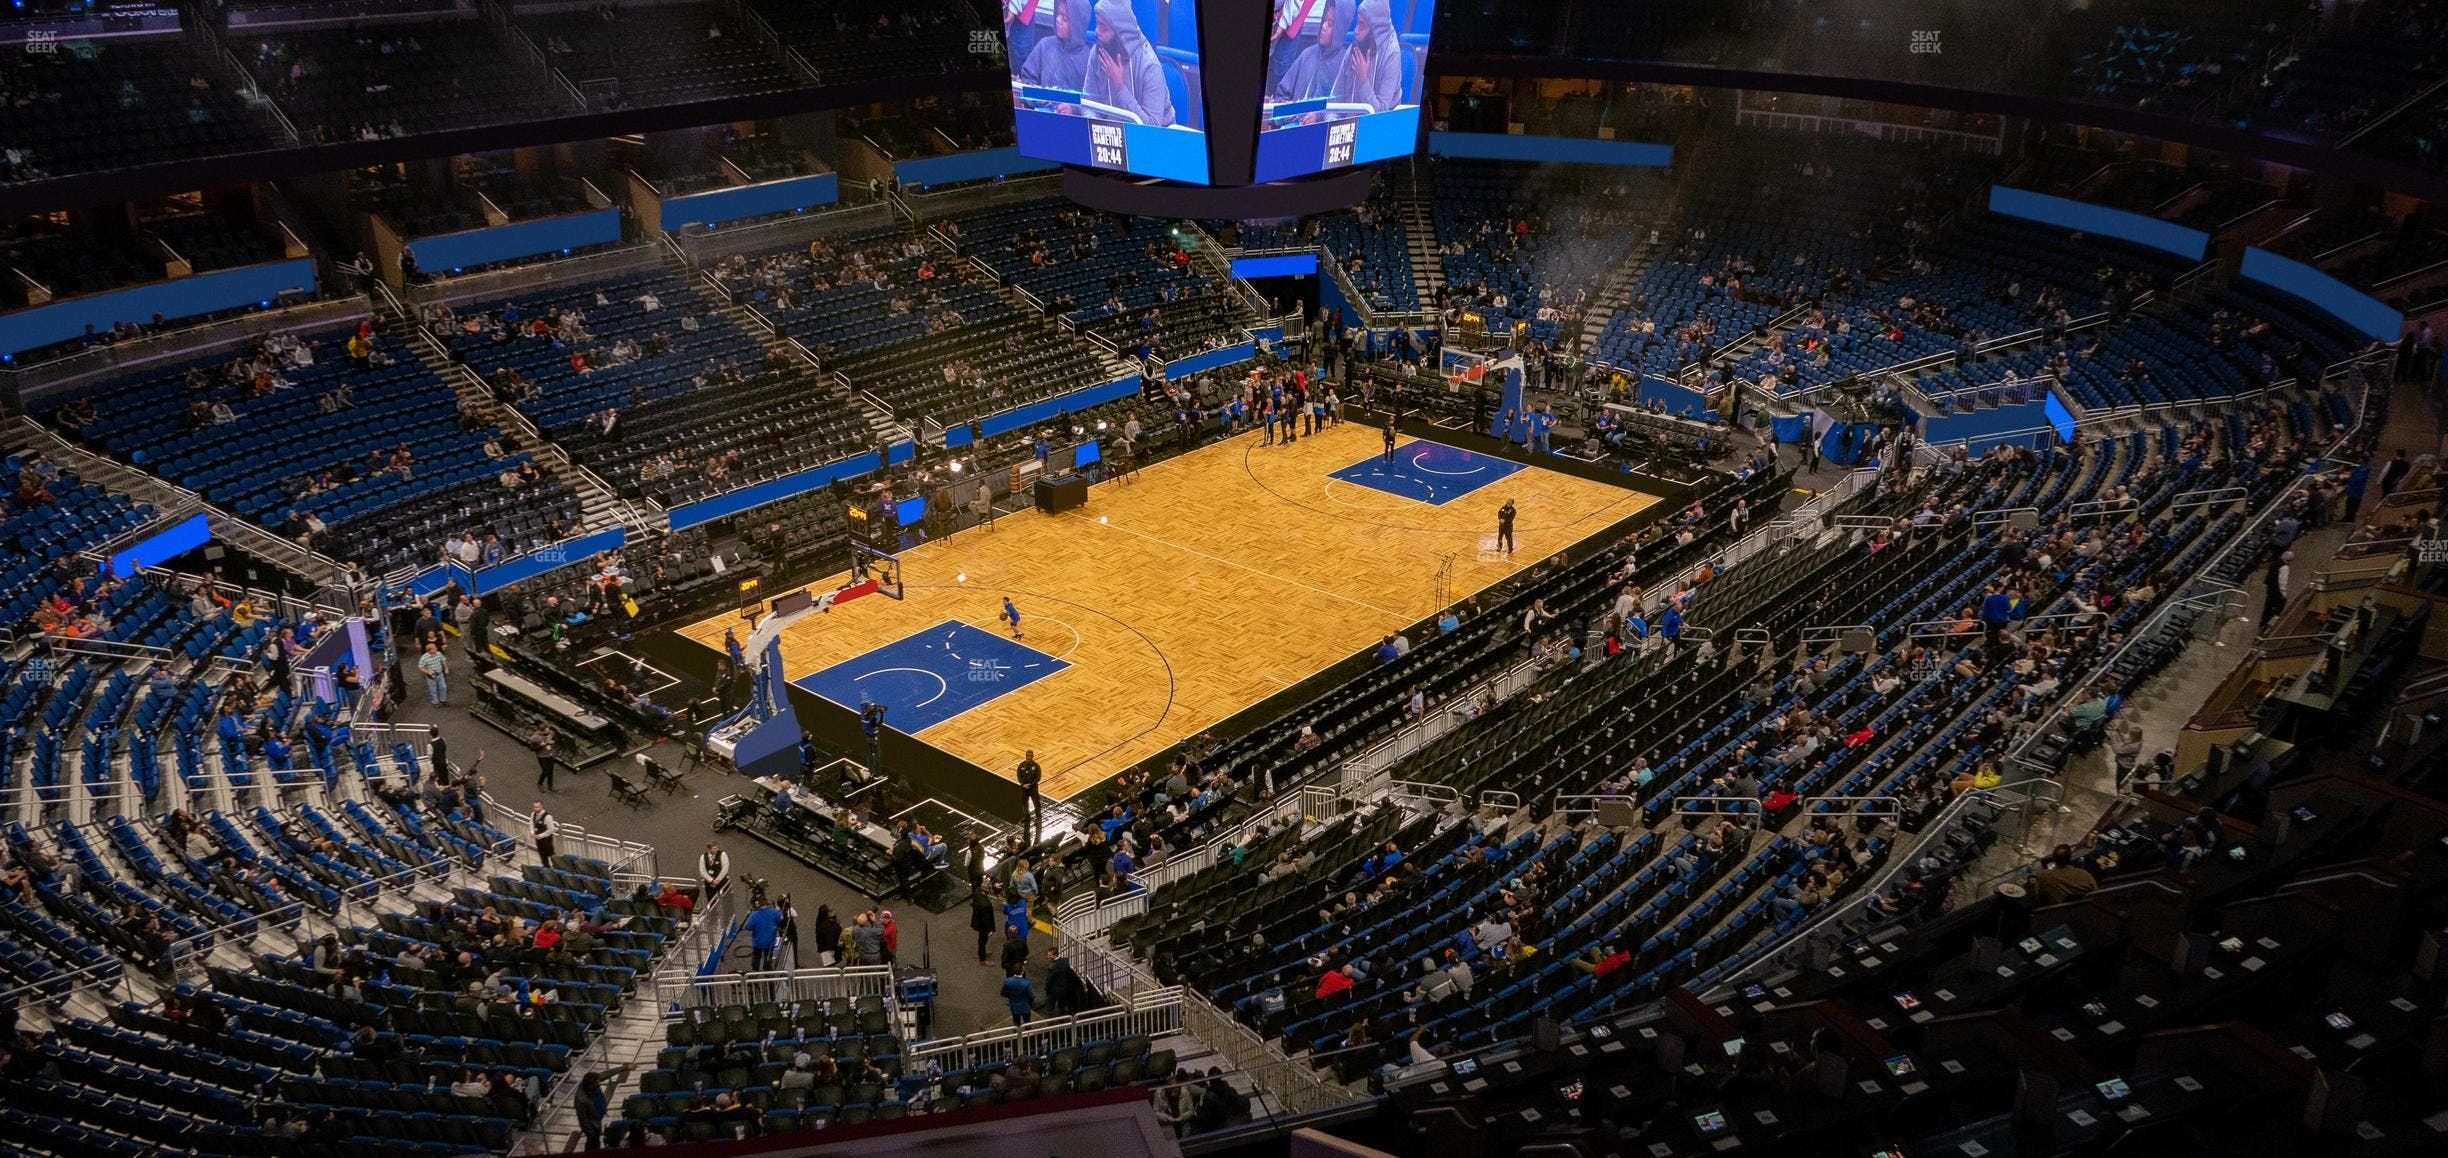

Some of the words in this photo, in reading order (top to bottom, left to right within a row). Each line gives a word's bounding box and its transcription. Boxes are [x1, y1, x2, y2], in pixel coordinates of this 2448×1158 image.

[1093, 132, 1122, 147] GAMETIME
[1329, 131, 1354, 146] GAMETIME
[1097, 146, 1122, 165] 20:44
